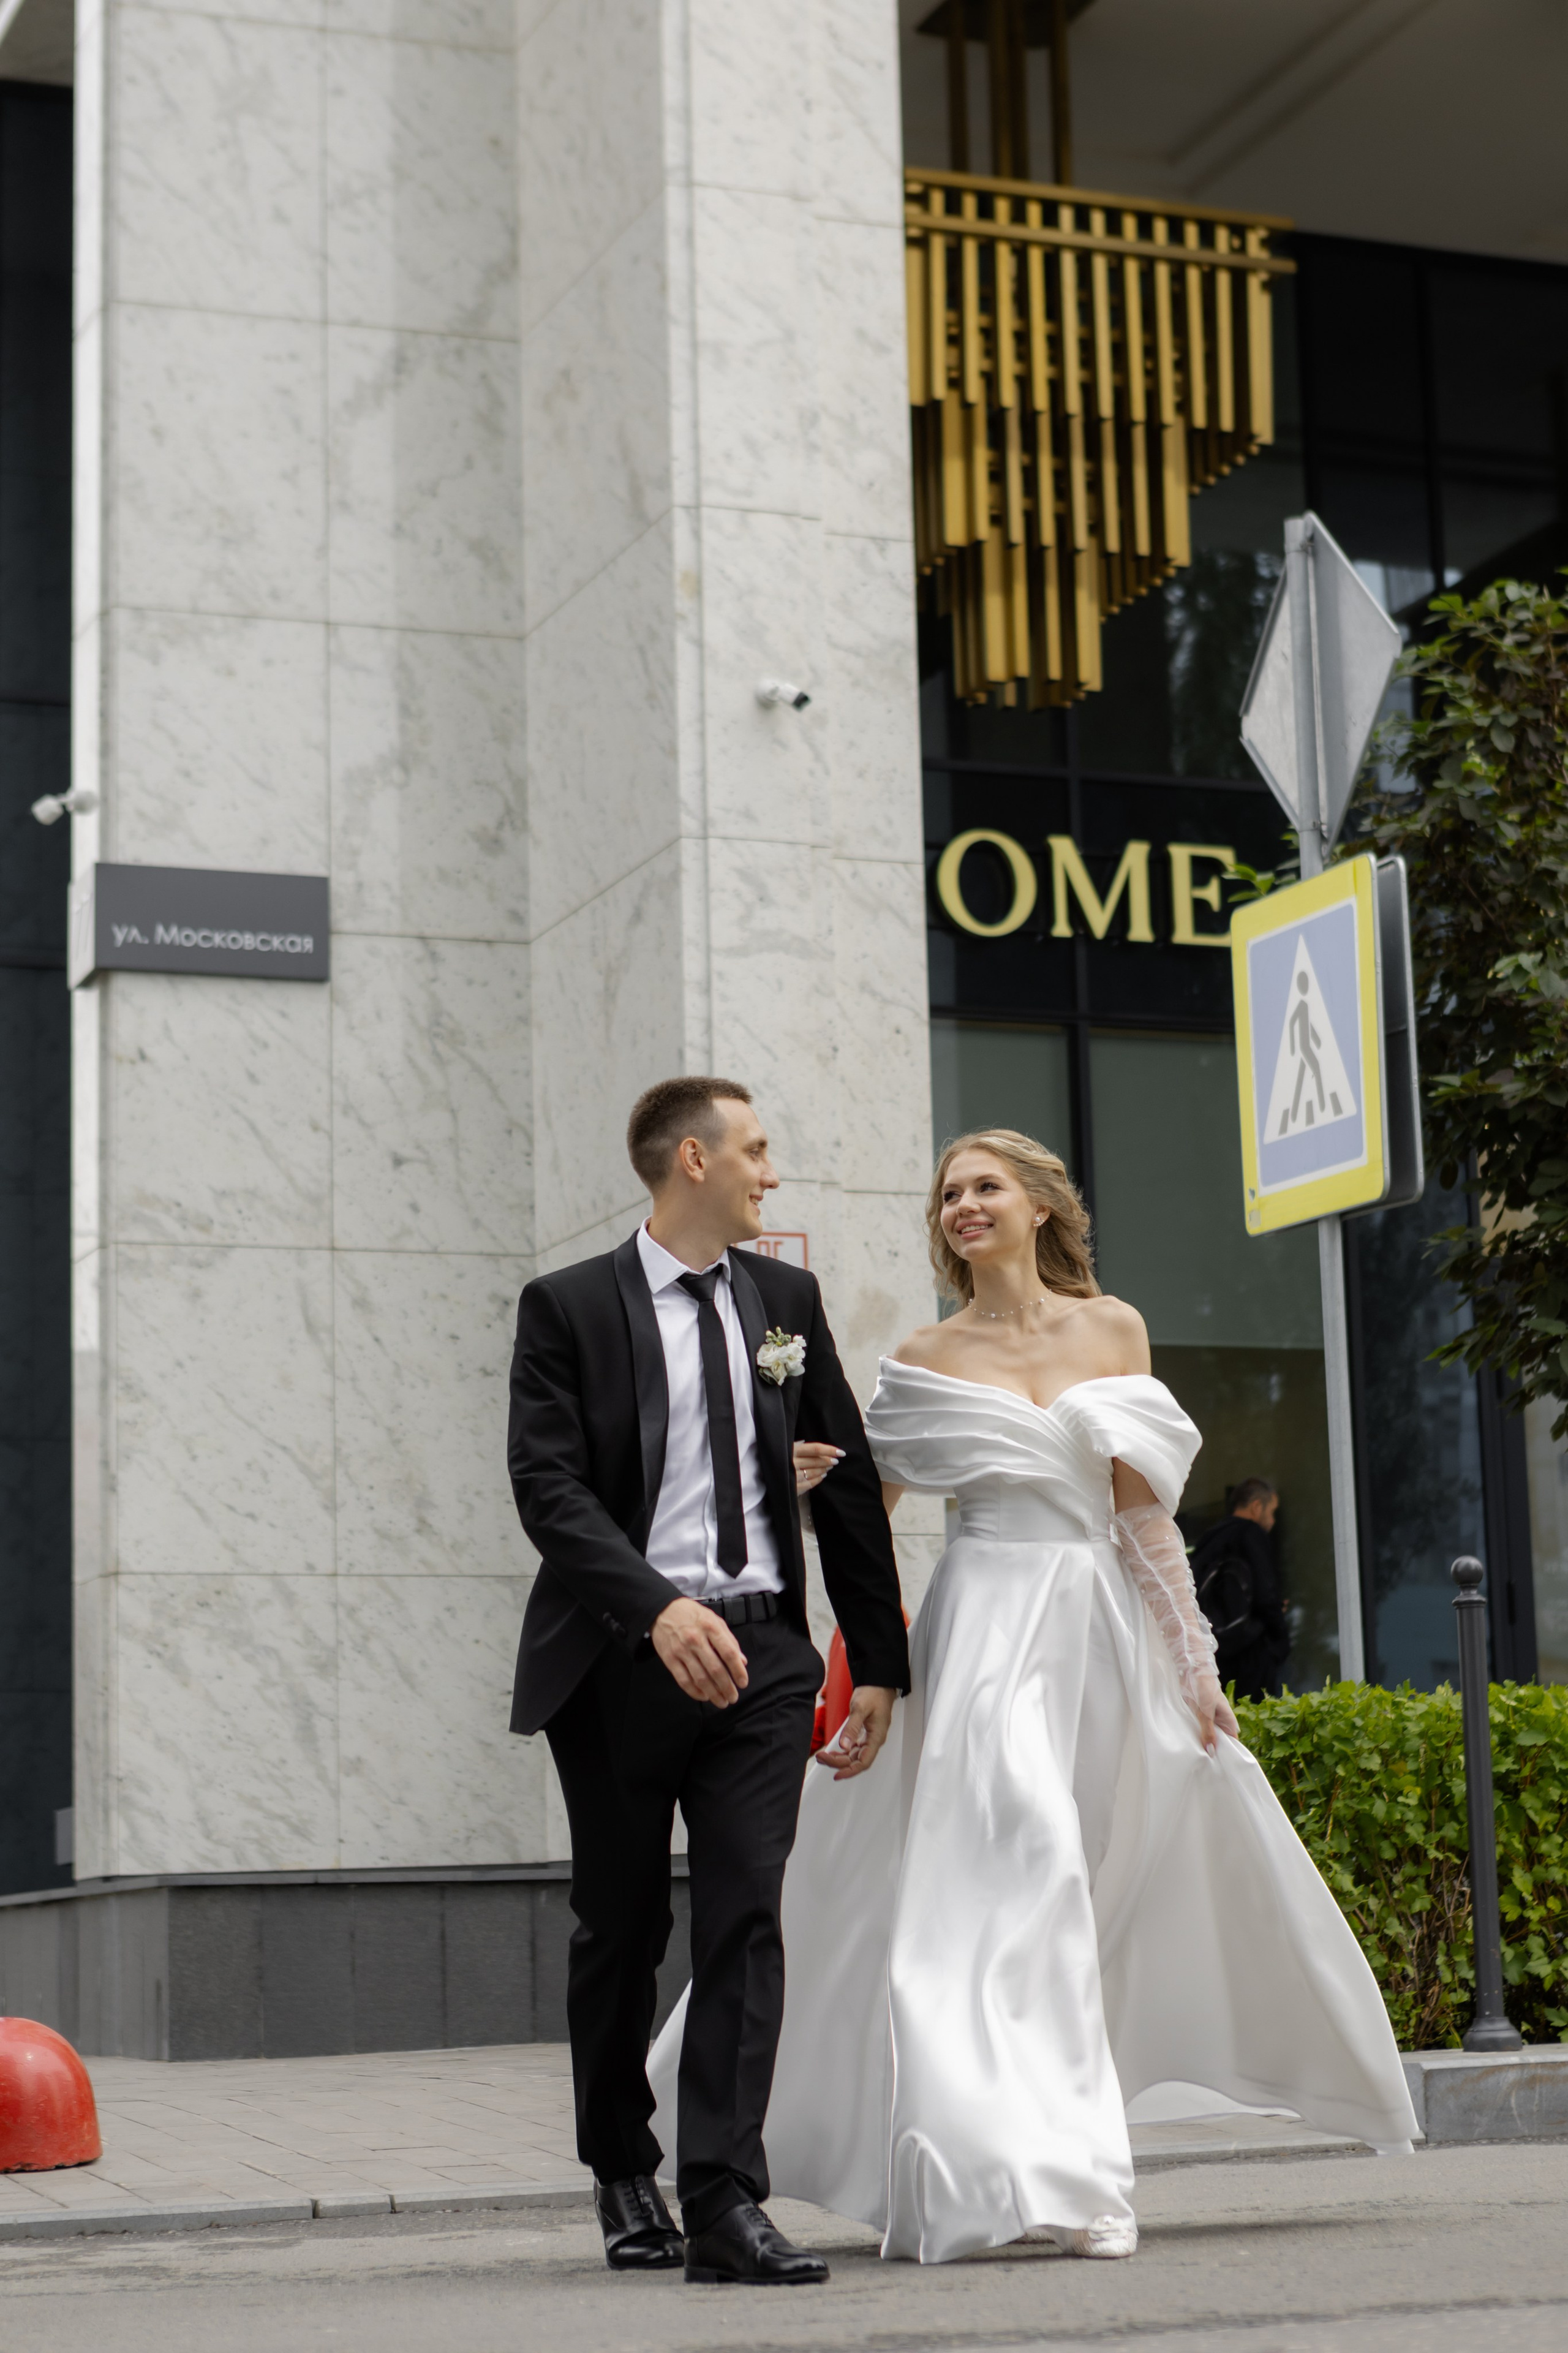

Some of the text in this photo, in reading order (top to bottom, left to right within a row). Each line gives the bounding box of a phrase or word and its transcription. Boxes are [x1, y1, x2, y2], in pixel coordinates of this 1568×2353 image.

[937, 828, 1237, 947] OME
[112, 922, 314, 954] ул. Московская
